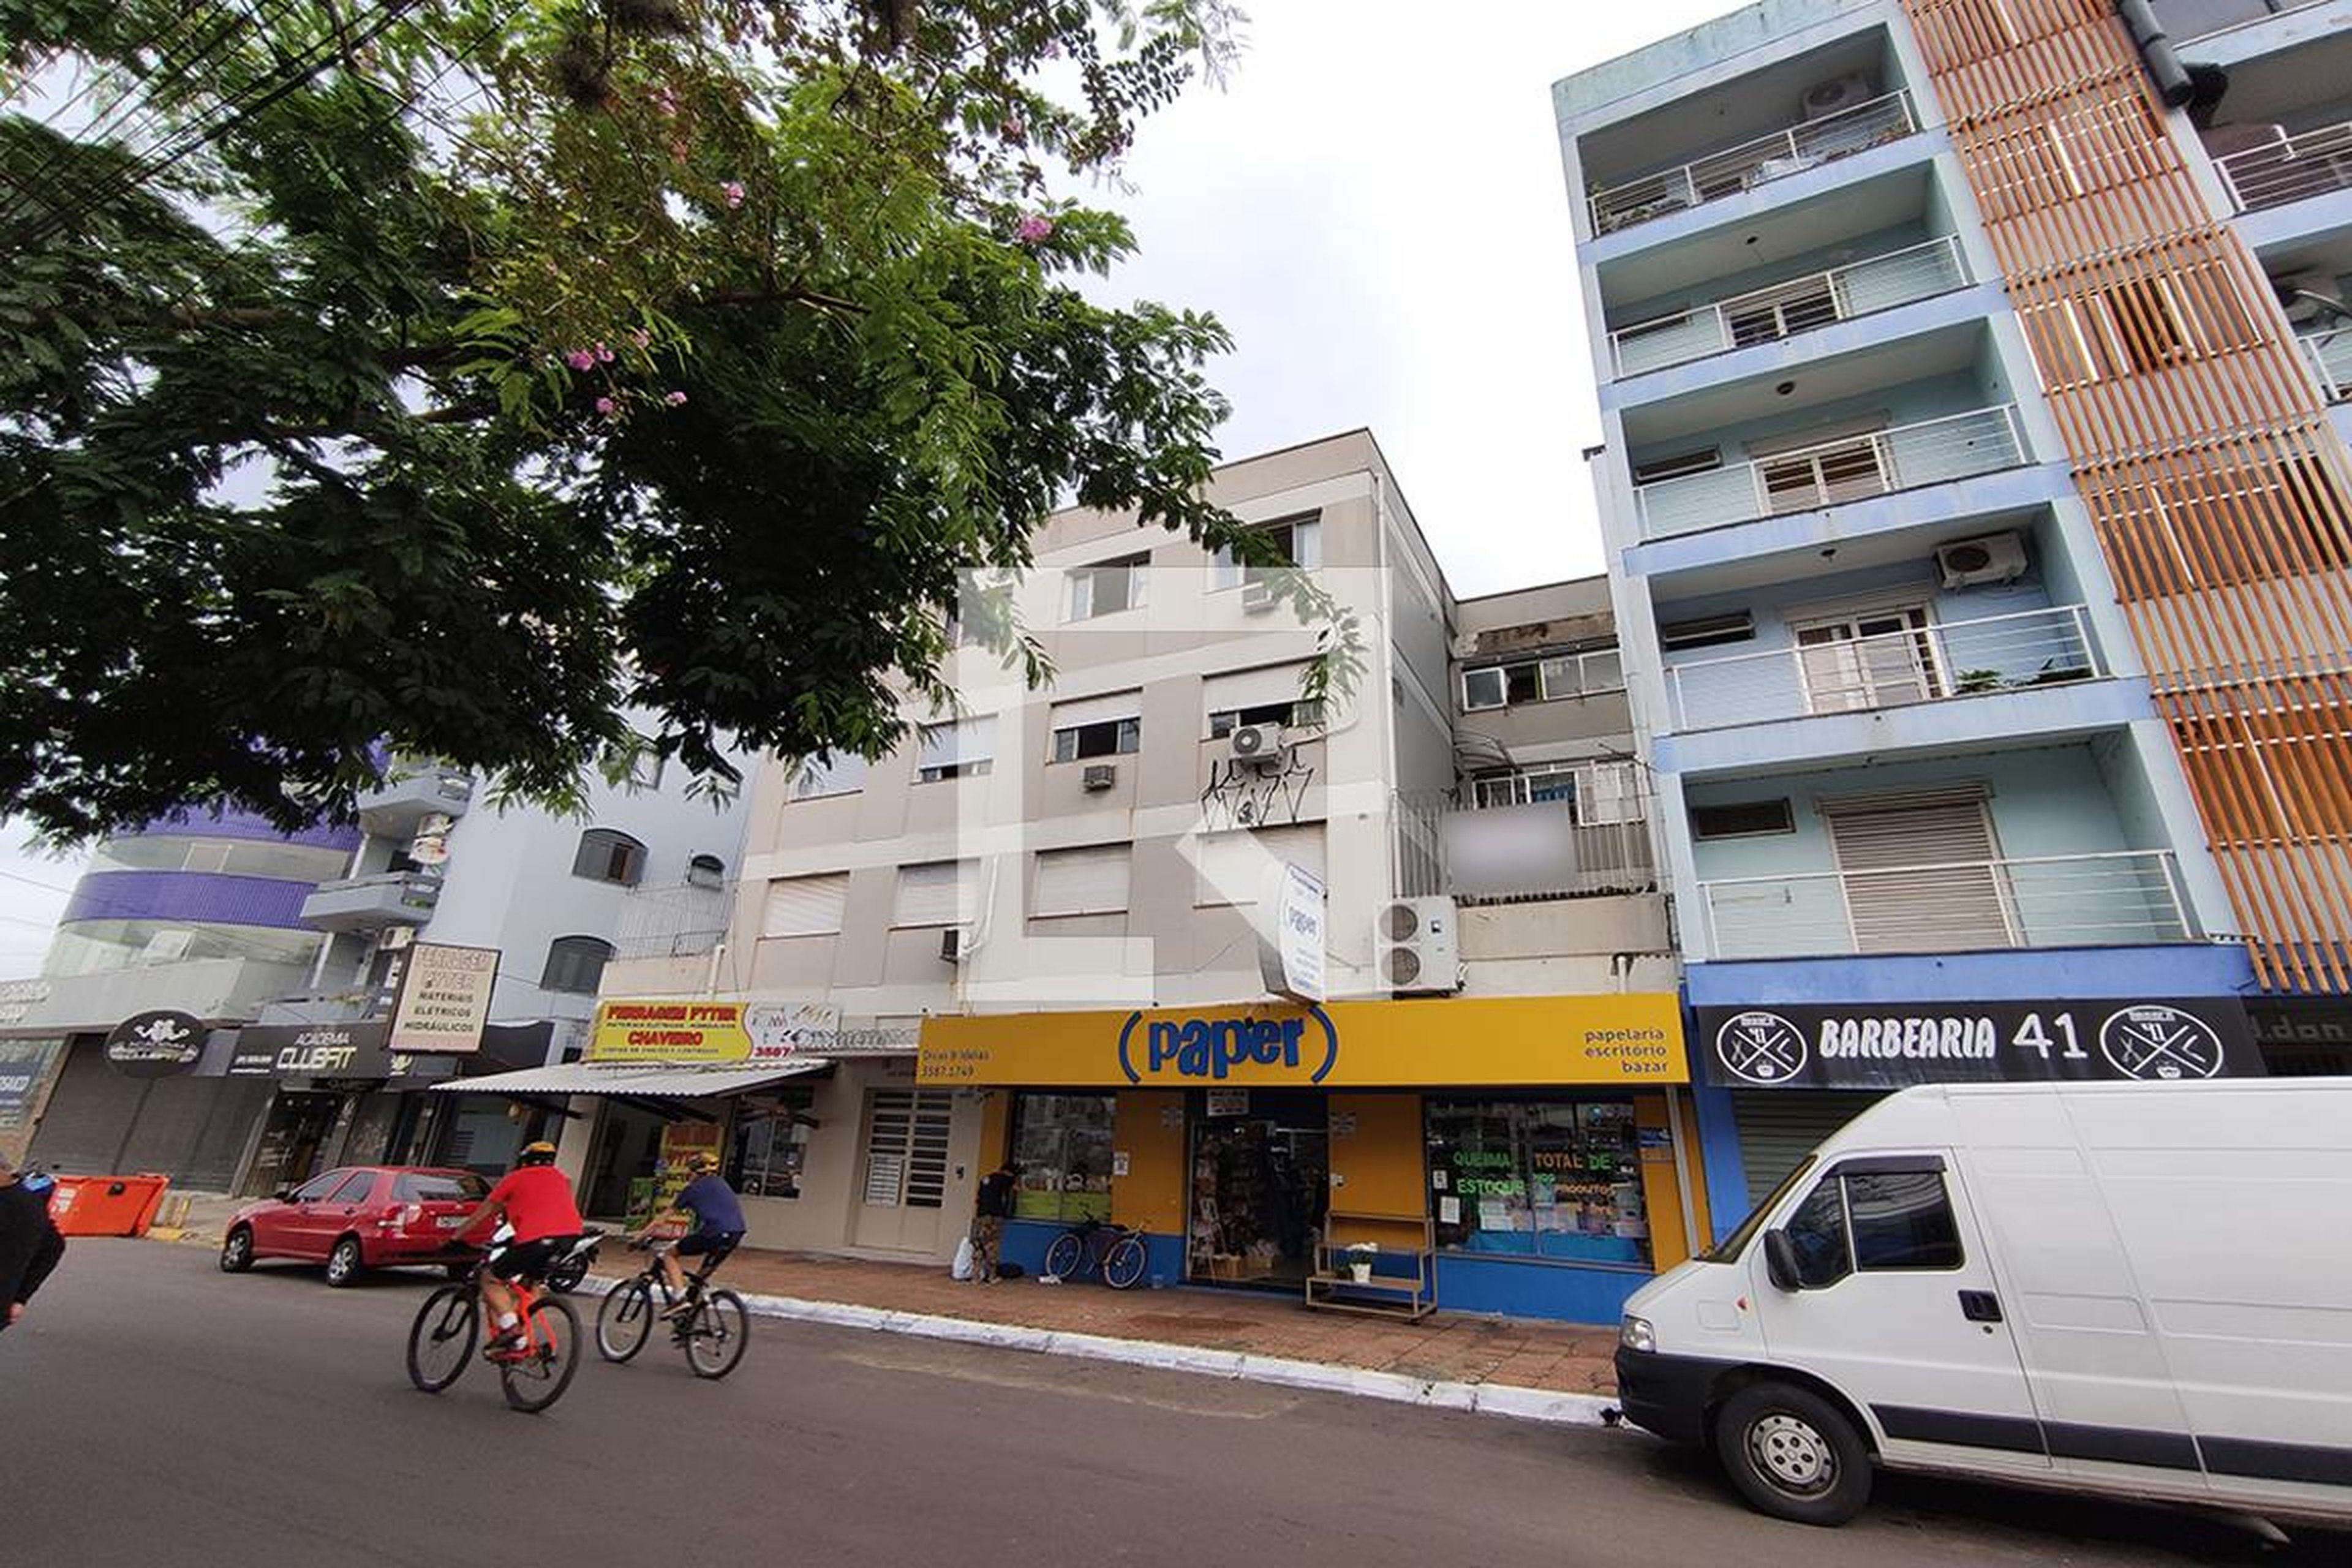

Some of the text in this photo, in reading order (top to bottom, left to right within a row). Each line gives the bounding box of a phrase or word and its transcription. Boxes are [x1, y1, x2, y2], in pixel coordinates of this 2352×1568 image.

[628, 1030, 704, 1046] CHAVEIRO
[1585, 1028, 1665, 1044] papelaria
[1819, 1012, 2089, 1059] BARBEARIA 41
[1621, 1059, 1668, 1073] bazar
[1453, 1152, 1611, 1171] QUEIMA TOTAL DE
